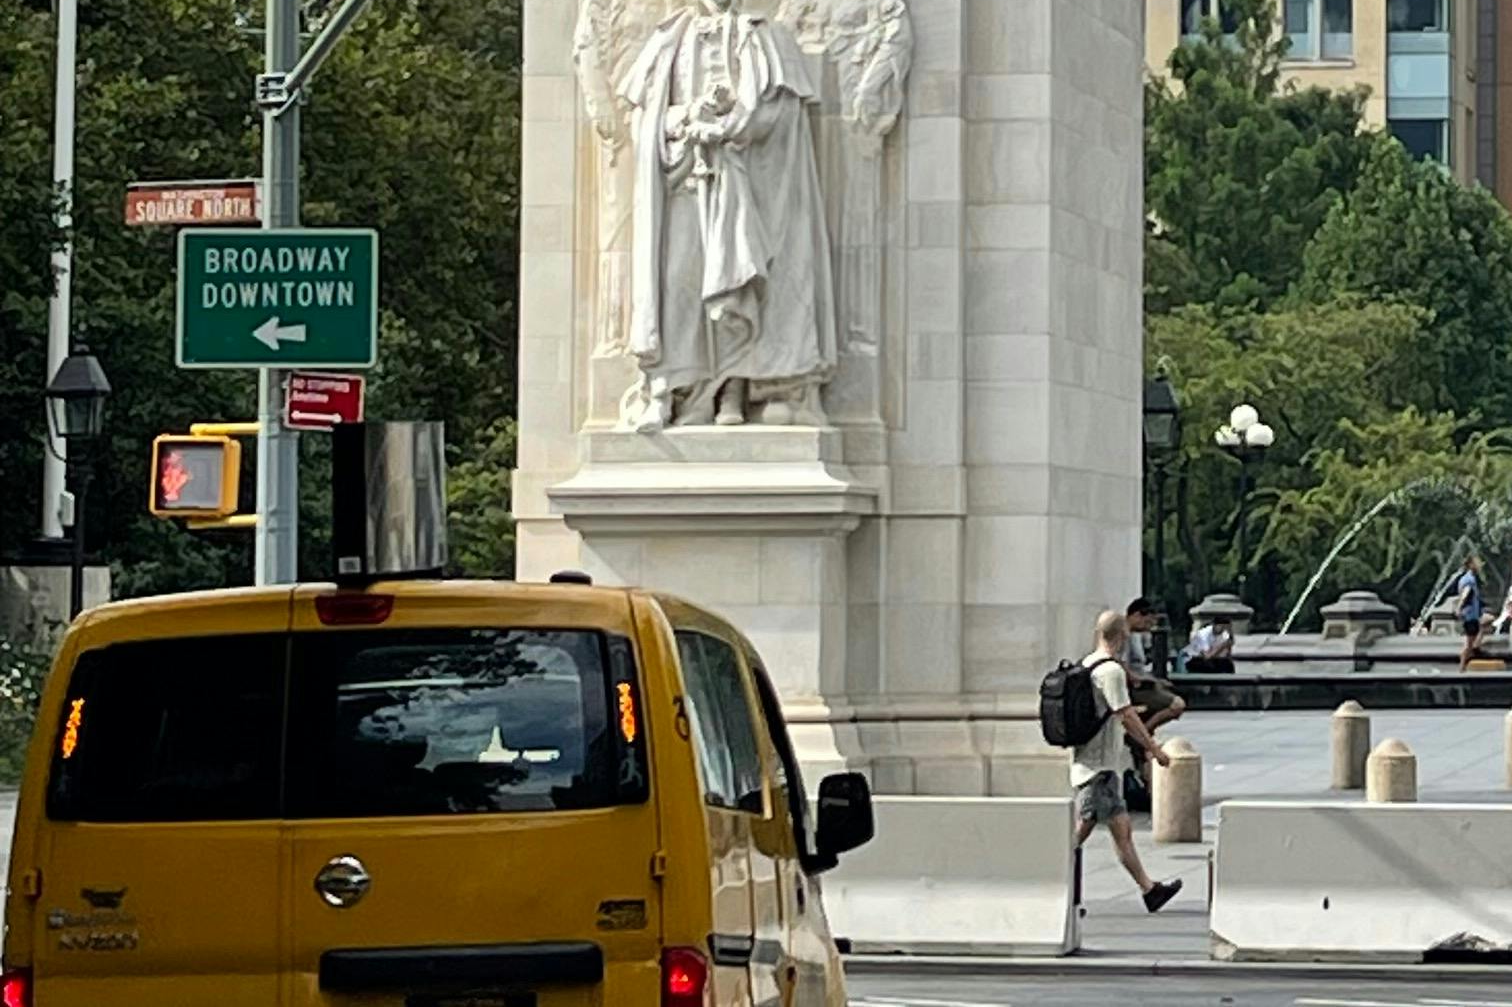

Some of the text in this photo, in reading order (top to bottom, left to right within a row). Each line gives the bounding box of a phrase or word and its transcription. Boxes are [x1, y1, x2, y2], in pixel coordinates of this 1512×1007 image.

[135, 197, 251, 222] SQUARE NORTH
[204, 246, 350, 274] BROADWAY
[202, 280, 354, 309] DOWNTOWN
